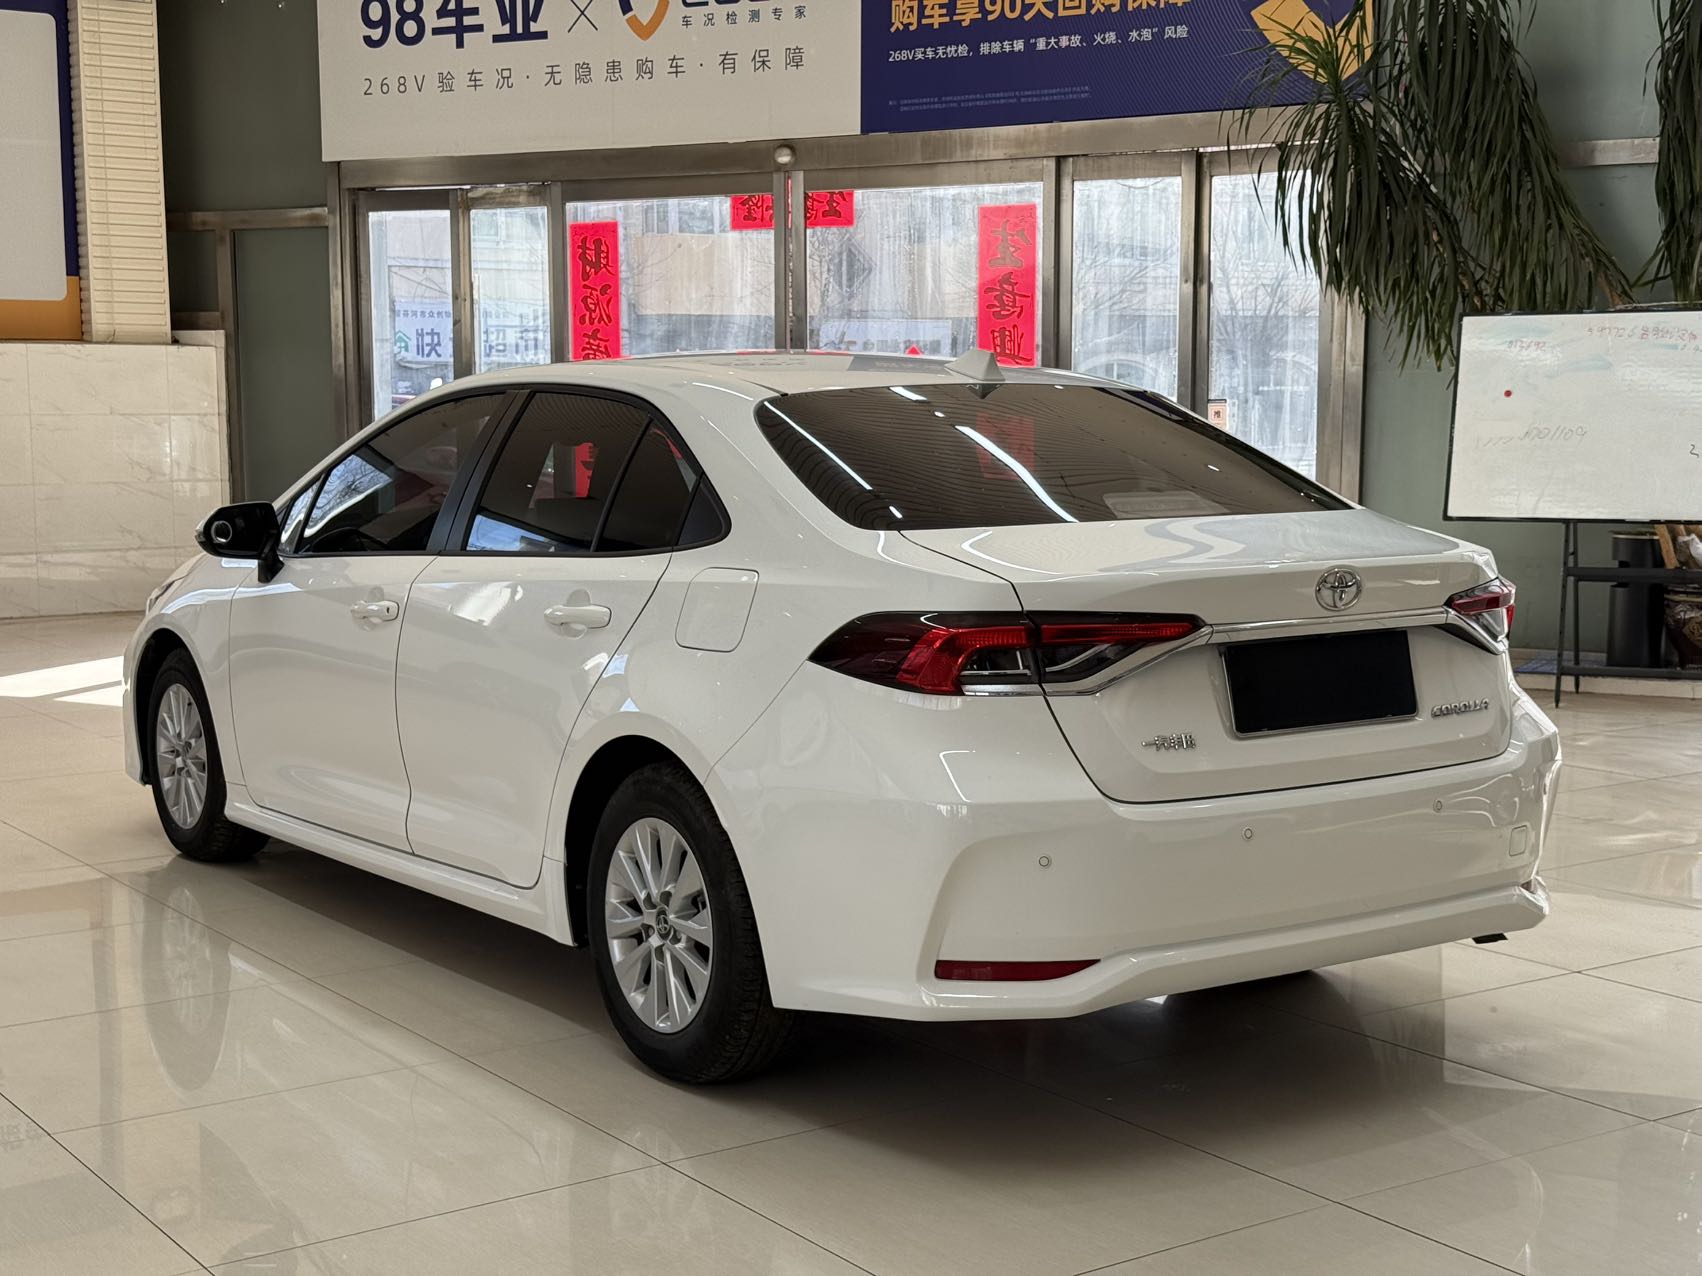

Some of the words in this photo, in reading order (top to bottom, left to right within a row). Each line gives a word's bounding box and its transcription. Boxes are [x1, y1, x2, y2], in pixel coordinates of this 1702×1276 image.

[361, 0, 549, 49] 98车业
[681, 5, 807, 29] 车况检测专家
[889, 0, 1191, 33] 购车享90天回
[1430, 697, 1490, 718] COROLLA
